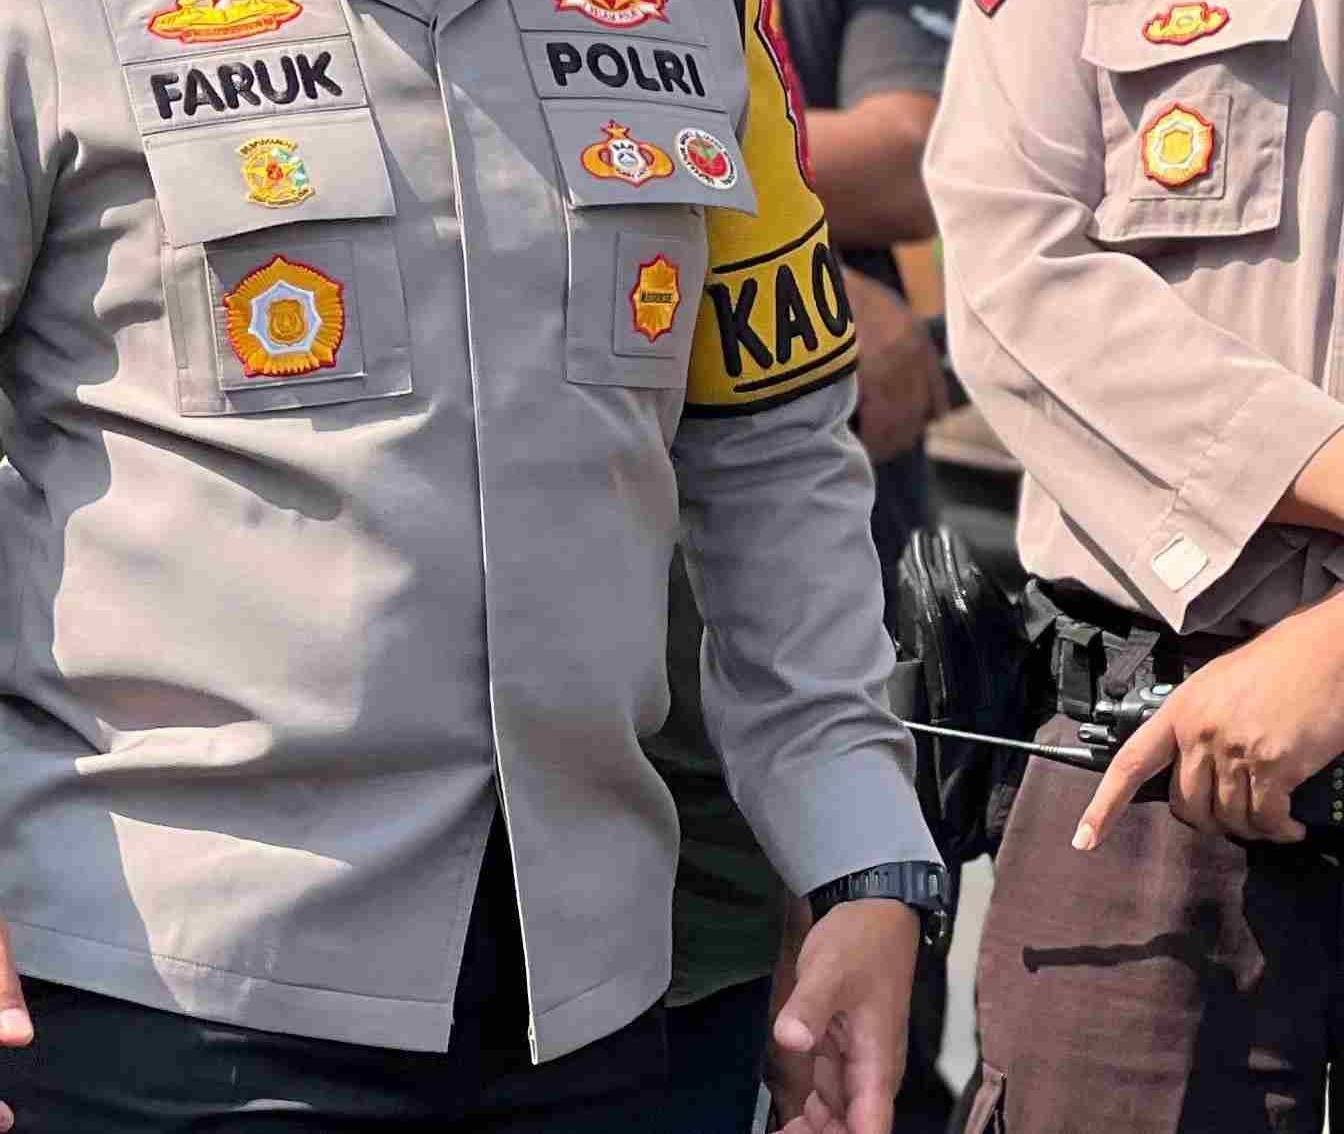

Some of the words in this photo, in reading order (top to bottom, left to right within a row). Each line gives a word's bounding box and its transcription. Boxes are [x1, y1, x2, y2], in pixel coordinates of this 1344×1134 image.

[150, 51, 343, 119] FARUK
[546, 42, 706, 97] POLRI
[706, 242, 854, 378] KAO
